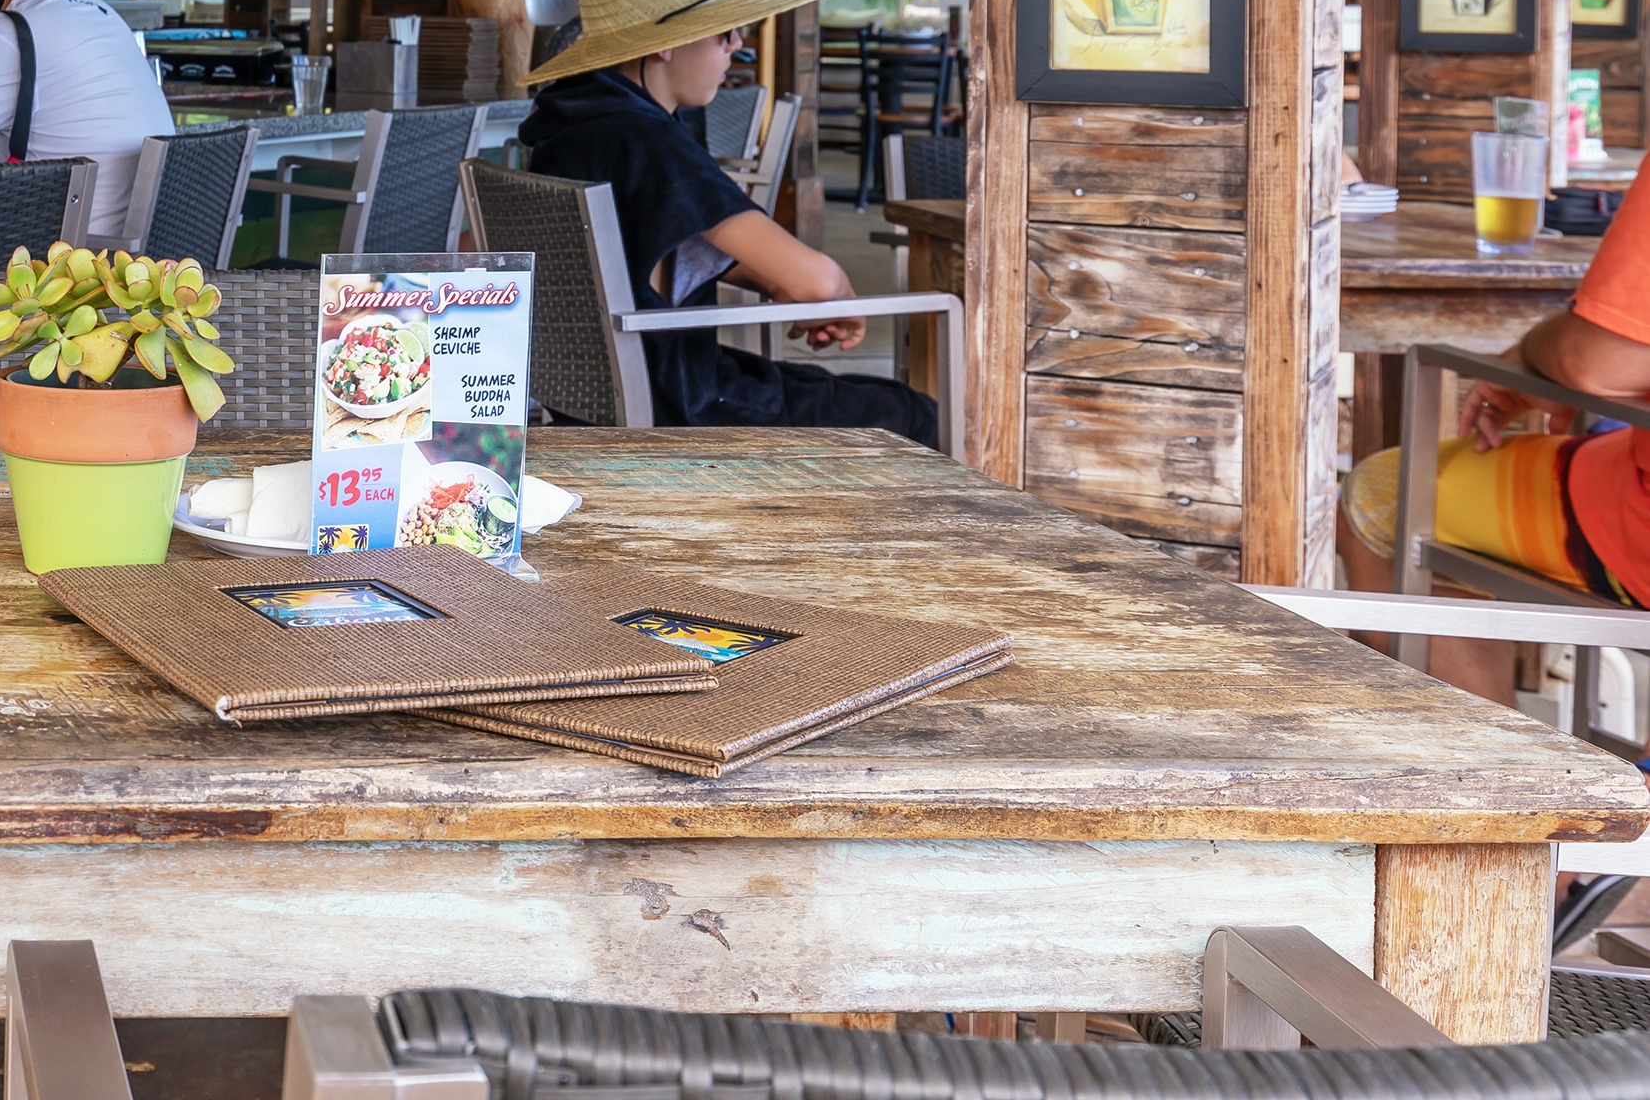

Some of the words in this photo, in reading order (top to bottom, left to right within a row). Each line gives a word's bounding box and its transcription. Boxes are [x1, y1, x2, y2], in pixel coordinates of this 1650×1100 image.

[322, 285, 432, 317] Summer
[422, 282, 519, 314] Specials
[434, 327, 481, 340] SHRIMP
[433, 342, 481, 355] CEVICHE
[461, 374, 516, 388] SUMMER
[465, 390, 511, 403] BUDDHA
[470, 405, 505, 418] SALAD
[365, 488, 394, 501] EACH
